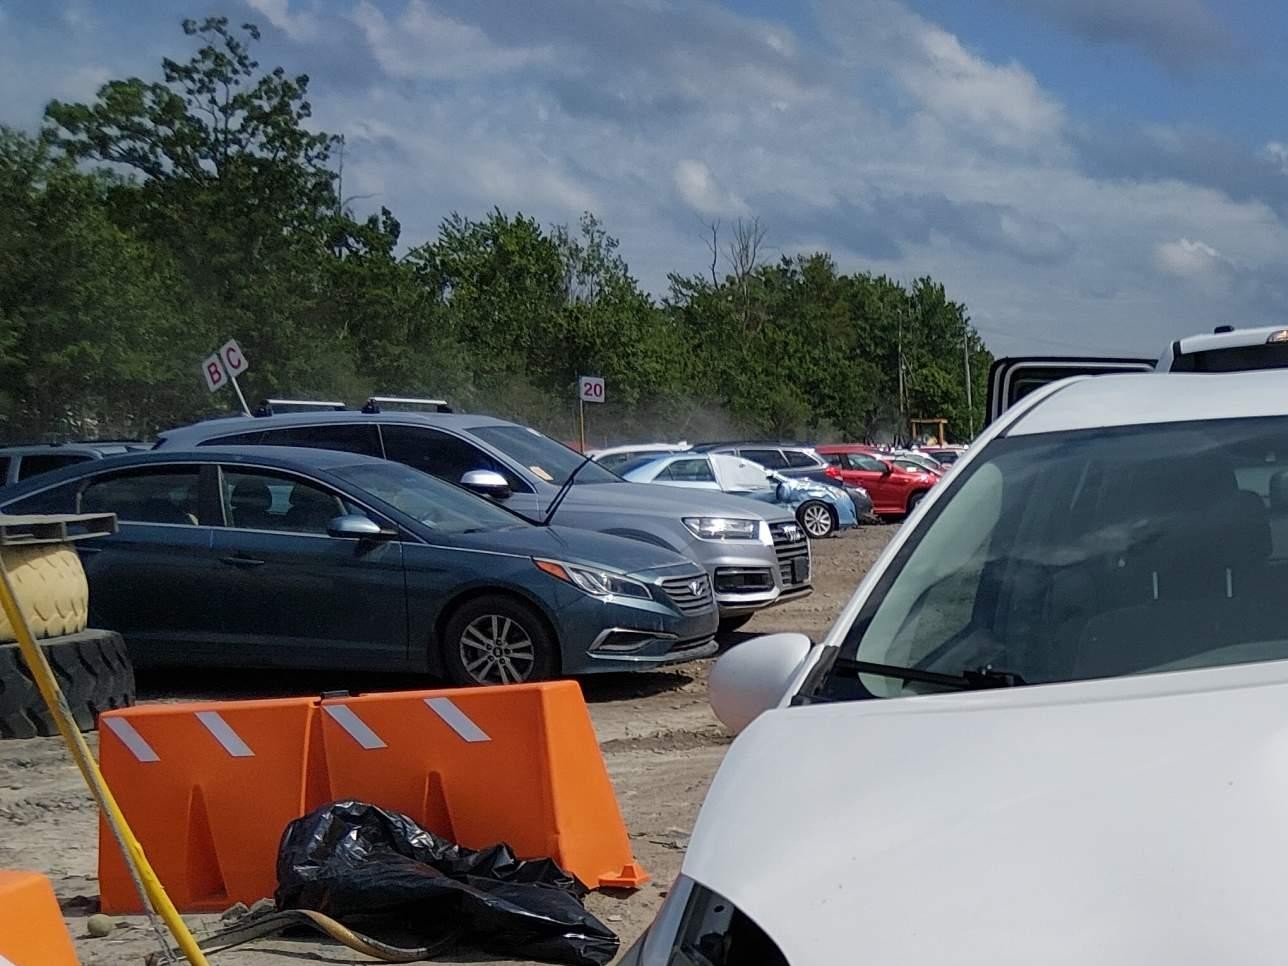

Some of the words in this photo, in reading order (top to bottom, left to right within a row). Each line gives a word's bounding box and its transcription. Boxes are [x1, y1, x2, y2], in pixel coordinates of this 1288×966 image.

[207, 362, 222, 385] B
[226, 346, 242, 369] C
[583, 382, 603, 398] 20
